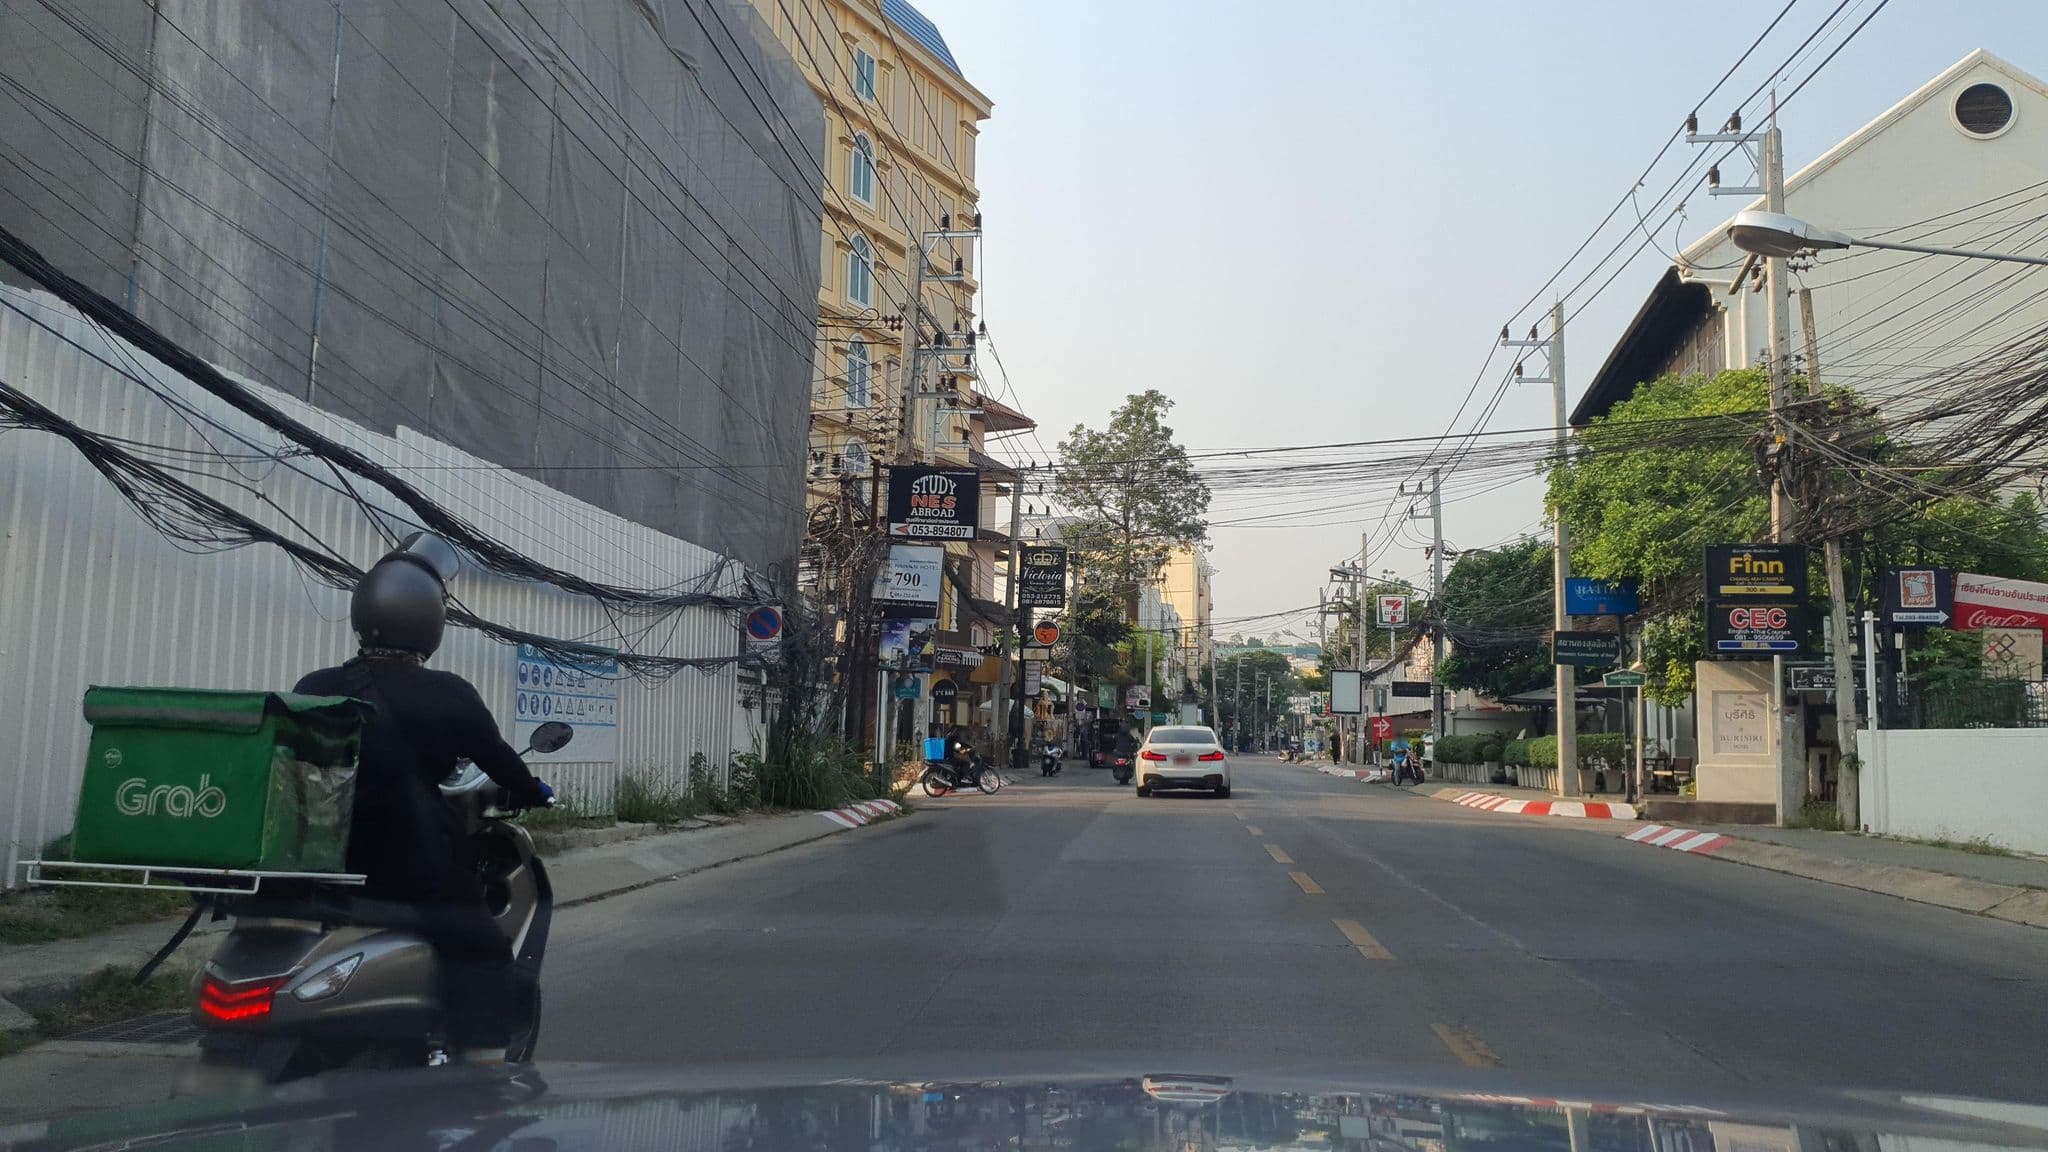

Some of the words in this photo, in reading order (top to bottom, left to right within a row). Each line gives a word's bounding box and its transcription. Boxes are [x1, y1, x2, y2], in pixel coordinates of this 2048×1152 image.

[912, 475, 957, 494] STUDY
[911, 495, 957, 509] NES
[910, 508, 955, 518] ABROAD
[912, 525, 968, 537] 053-894807
[1729, 552, 1784, 574] Finn
[895, 572, 921, 587] 790
[1023, 566, 1062, 580] Victoria
[1385, 599, 1402, 611] 7
[1729, 607, 1787, 629] CEC
[116, 774, 226, 818] Grab
